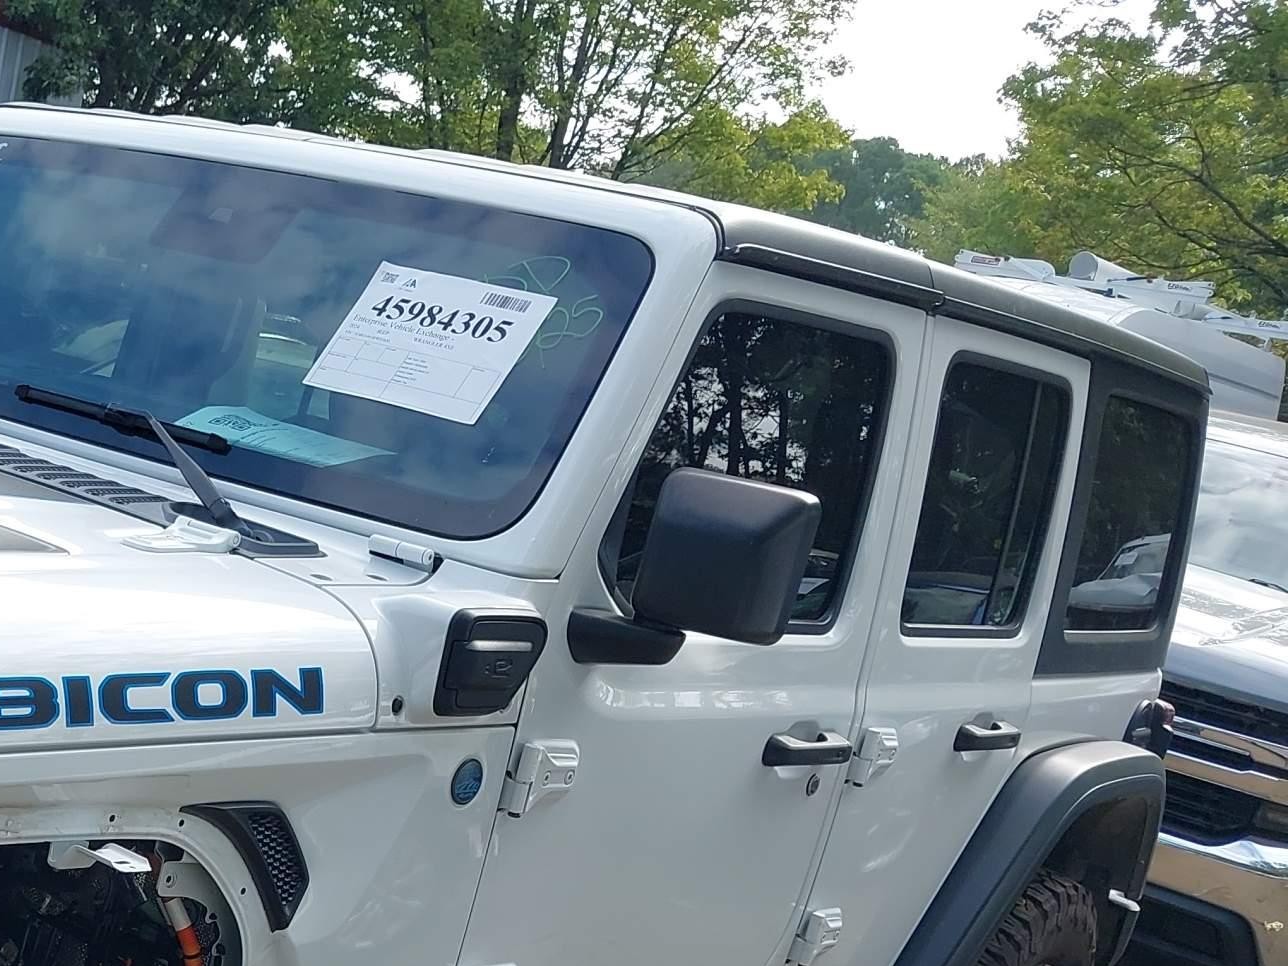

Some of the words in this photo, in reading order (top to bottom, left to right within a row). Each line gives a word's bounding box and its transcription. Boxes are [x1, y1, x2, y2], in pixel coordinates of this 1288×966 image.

[353, 314, 389, 328] Enterprise
[390, 321, 416, 333] Vehicle
[415, 327, 451, 341] Exchange
[370, 295, 515, 343] 45984305
